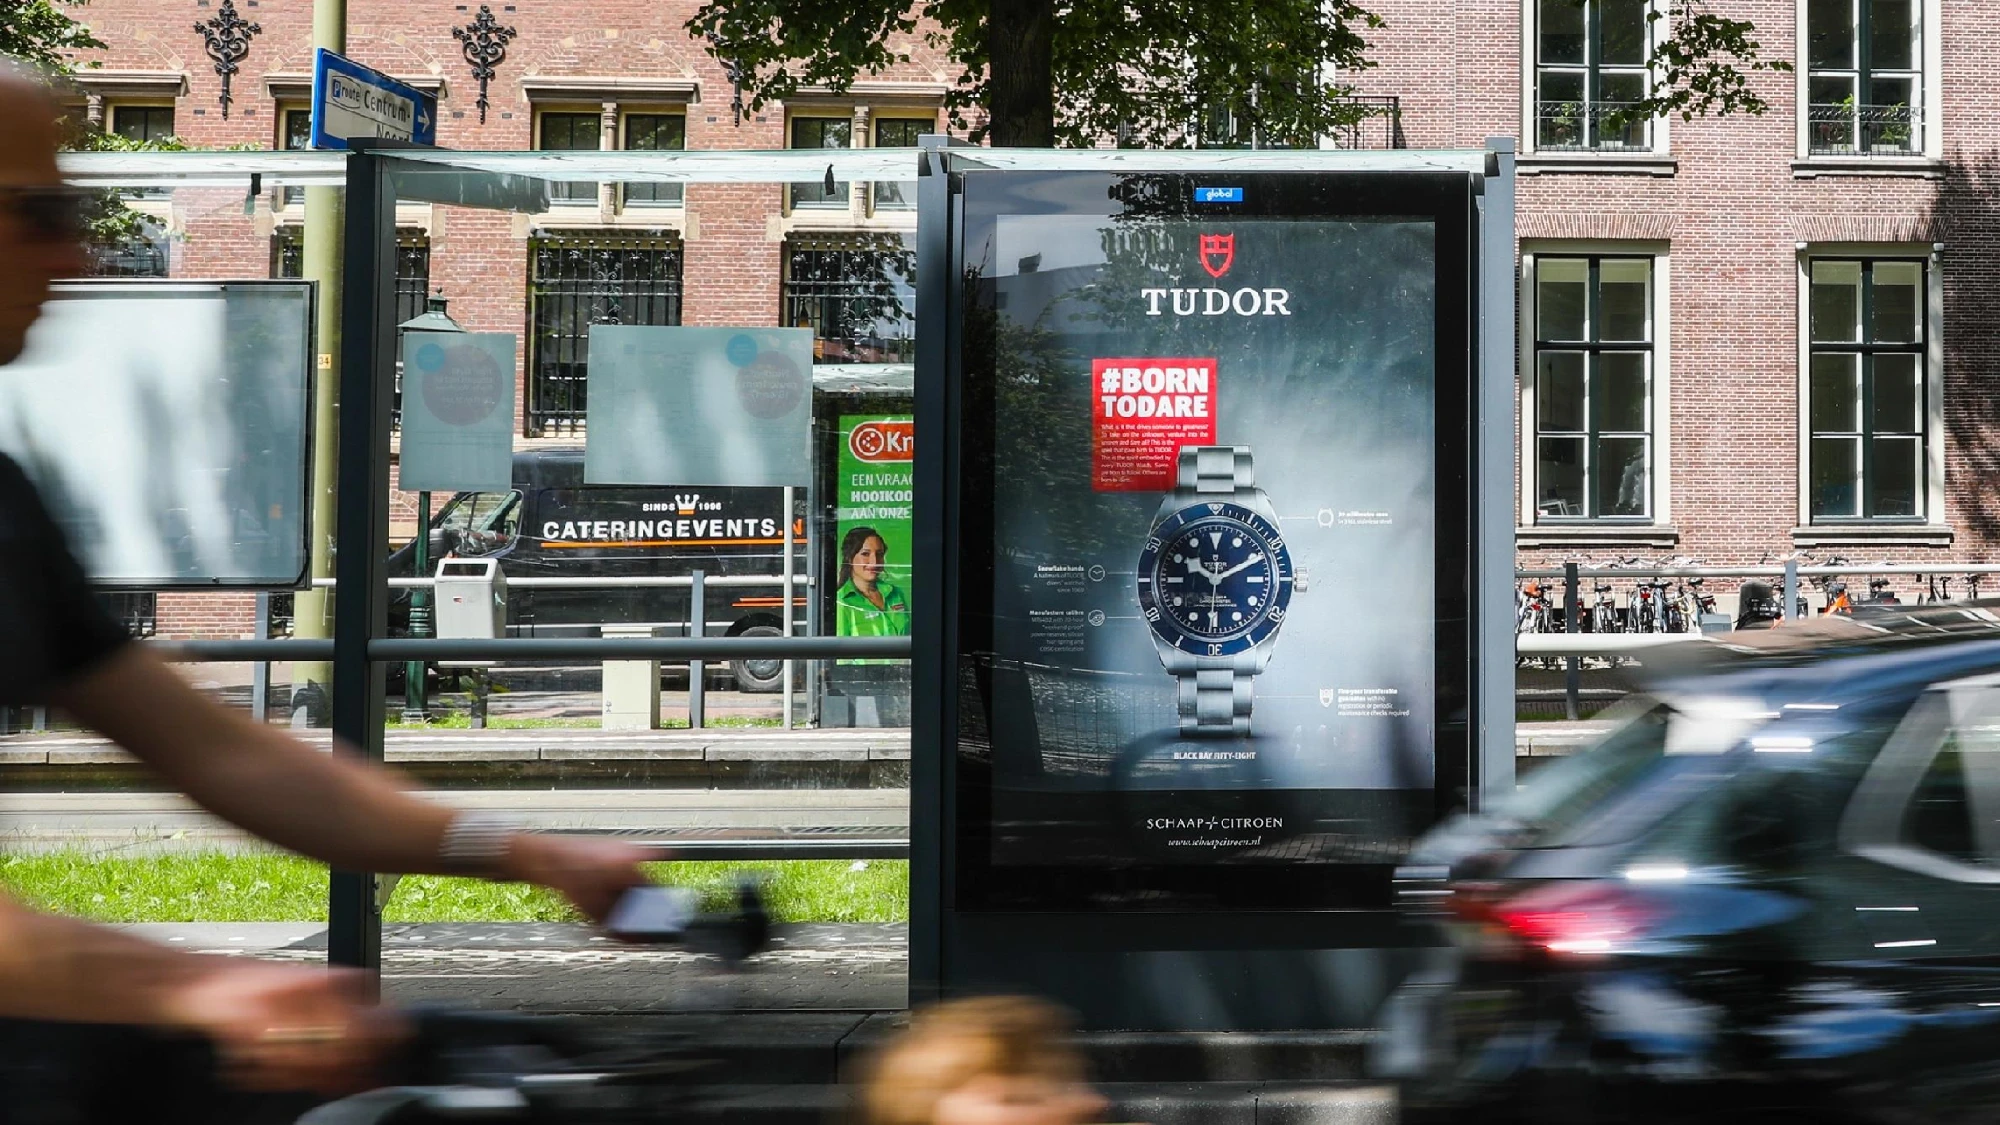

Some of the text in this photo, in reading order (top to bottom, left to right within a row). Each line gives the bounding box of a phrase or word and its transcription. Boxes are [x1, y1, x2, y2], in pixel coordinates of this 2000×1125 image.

[341, 86, 360, 102] route
[364, 90, 410, 123] Centrum-
[1206, 188, 1233, 201] global
[1141, 287, 1291, 316] TUDOR
[1101, 368, 1208, 393] #BORN
[1101, 395, 1208, 418] TODARE
[887, 431, 914, 452] Kr
[852, 474, 873, 486] EEN
[851, 490, 912, 502] HOOIKOO
[642, 503, 675, 511] SINDS
[851, 507, 911, 519] AAN ONZE
[1145, 537, 1162, 553] 50
[1271, 536, 1284, 550] 10
[1145, 606, 1160, 623] 40
[1268, 606, 1285, 623] 20
[1208, 644, 1222, 656] 30
[1174, 752, 1256, 760] BLACK BAY FIFTY-EIGHT
[1168, 836, 1262, 849] www.schaapcitroen.nl
